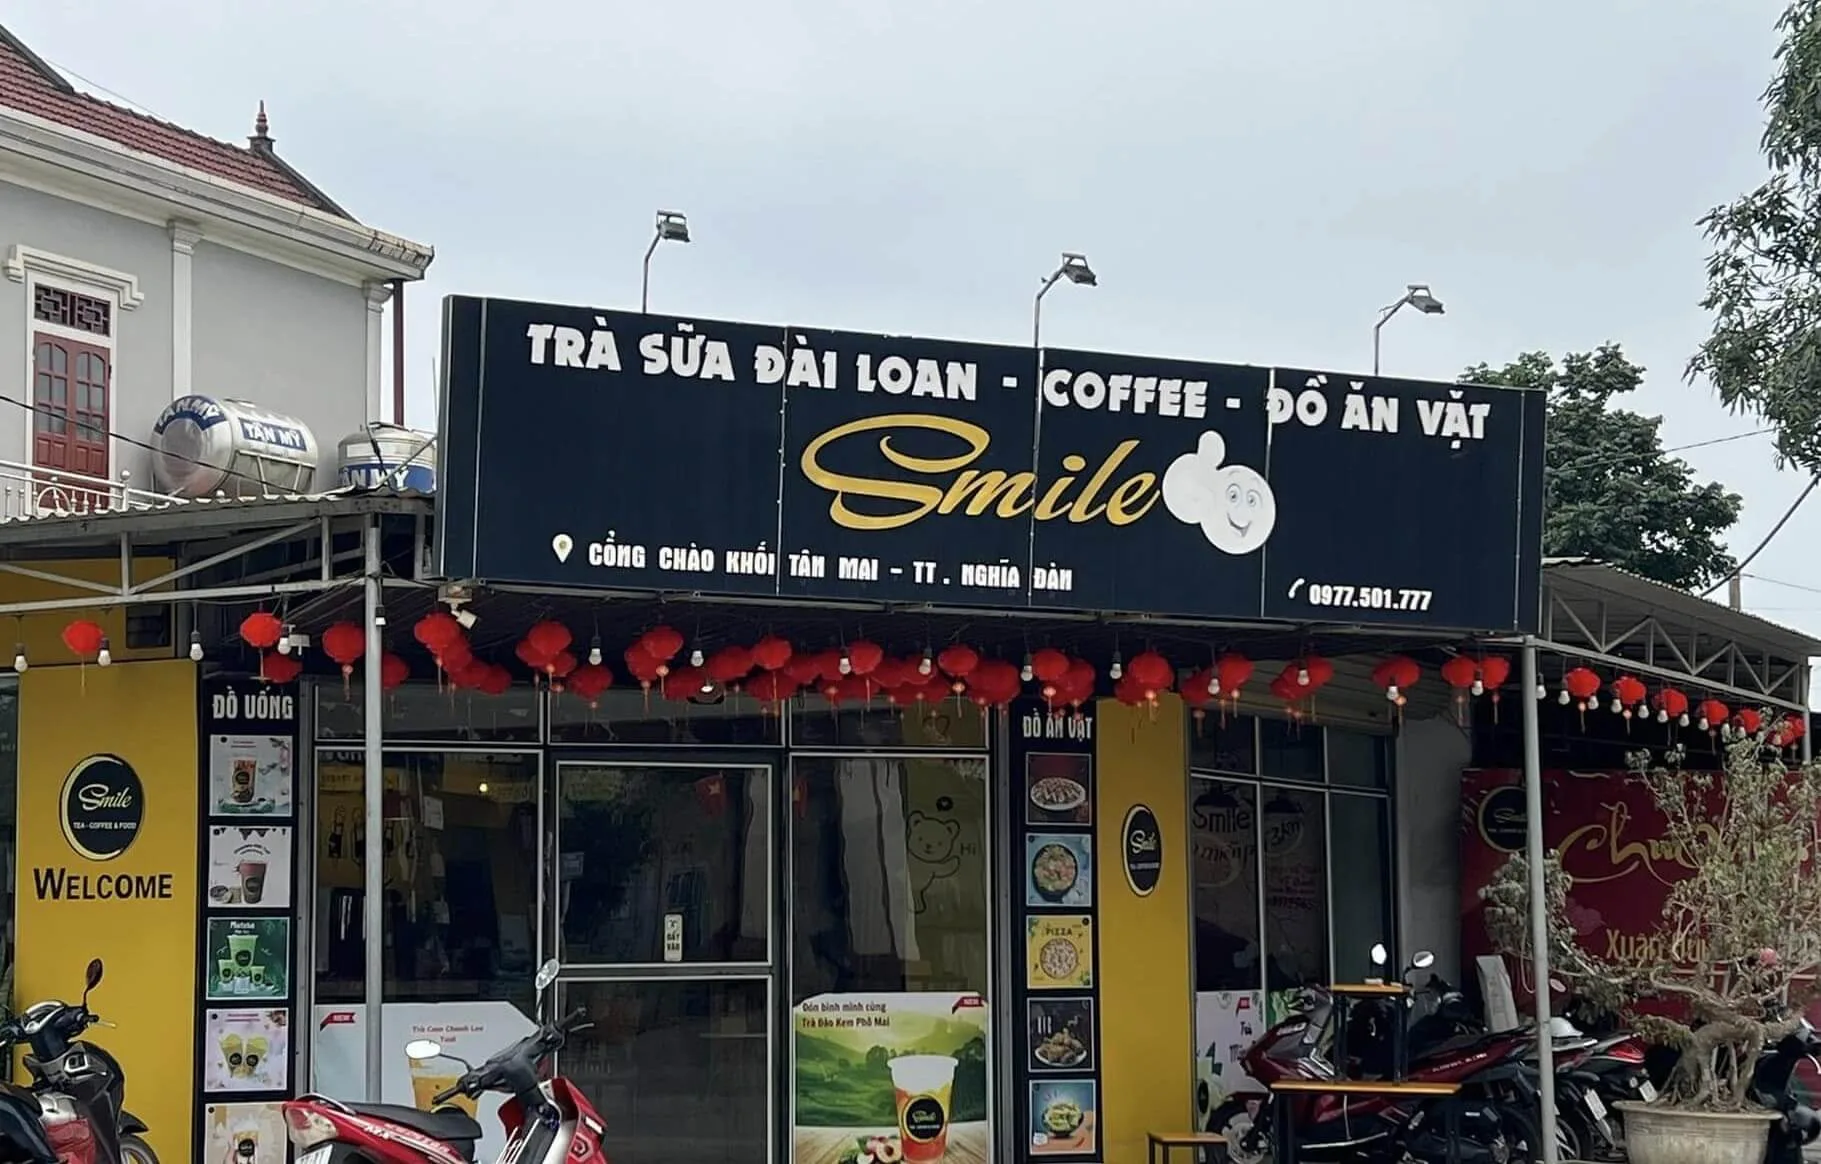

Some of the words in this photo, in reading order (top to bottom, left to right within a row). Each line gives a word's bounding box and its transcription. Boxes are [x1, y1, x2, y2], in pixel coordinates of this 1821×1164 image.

[527, 317, 622, 372] TRÀ
[639, 322, 736, 381] SỮA
[754, 335, 837, 389] ĐÀI
[856, 353, 977, 401] LOAN
[1043, 369, 1208, 419] COFFEE
[1266, 374, 1328, 427] ĐỒ
[1341, 381, 1399, 433] ĂN
[1416, 390, 1491, 449] VẶT
[800, 413, 1160, 530] Smile
[588, 530, 646, 568] CỔNG
[658, 542, 715, 572] CHÀO
[725, 541, 775, 575] KHỐI
[789, 549, 825, 578] TÂN
[838, 557, 879, 581] MAI
[913, 561, 937, 584] TT
[961, 559, 1021, 588] NGHĨA
[1033, 562, 1073, 591] ĐÀN
[1309, 584, 1433, 611] 0977.501.777
[212, 685, 238, 719] ĐỒ
[244, 685, 294, 720] UỐNG
[1022, 707, 1041, 738] ĐỒ
[1046, 712, 1064, 738] ĂN
[79, 784, 133, 811] Smile
[73, 822, 85, 830] TEA
[89, 822, 113, 830] COFFEE
[119, 822, 137, 830] FOOD
[960, 843, 977, 857] Hi
[33, 868, 173, 900] WELCOME
[1045, 927, 1073, 936] PIZZA
